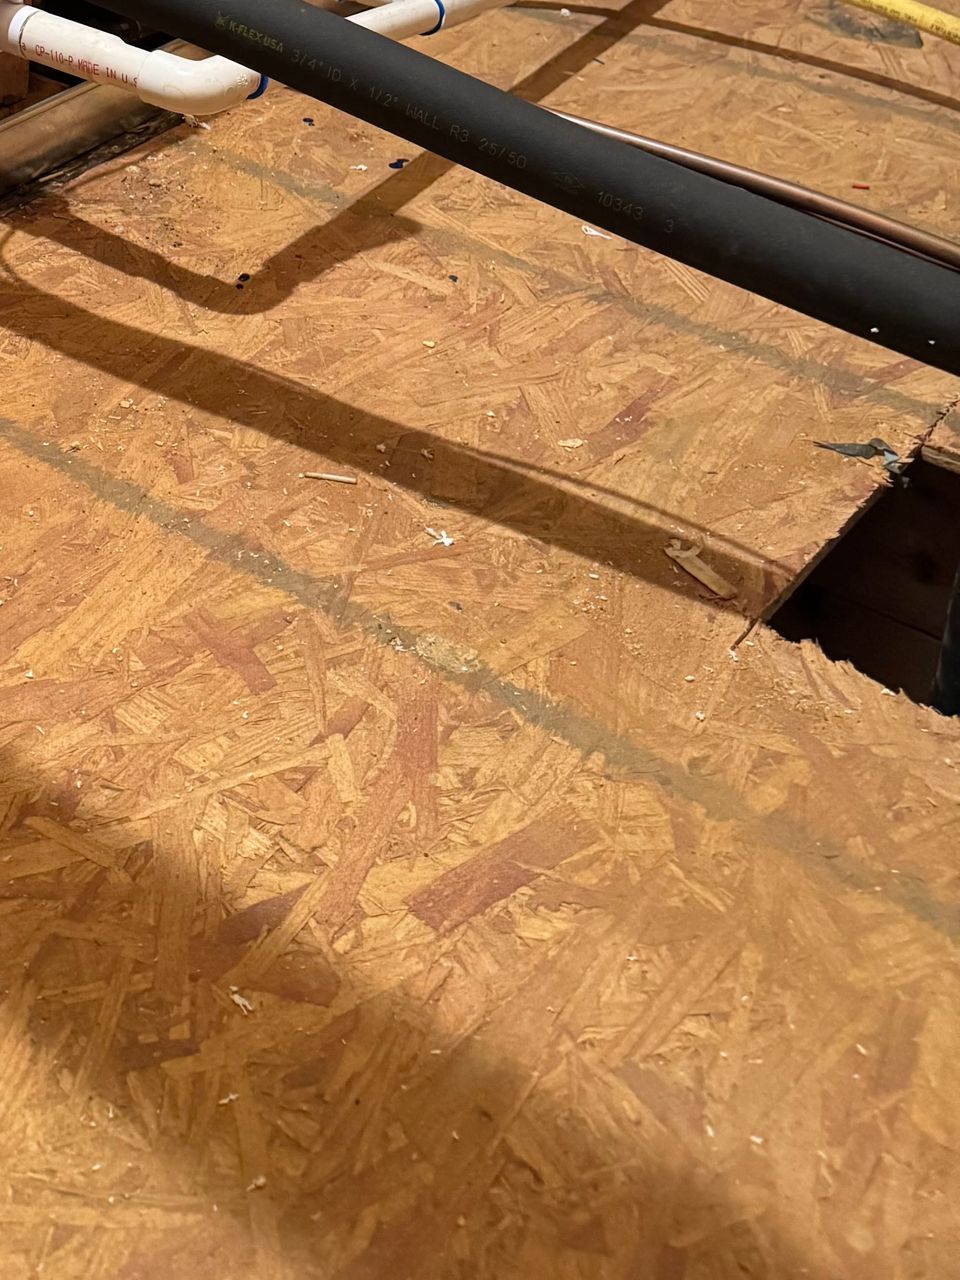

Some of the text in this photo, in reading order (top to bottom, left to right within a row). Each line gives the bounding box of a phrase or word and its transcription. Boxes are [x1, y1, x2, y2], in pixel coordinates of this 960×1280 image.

[78, 58, 100, 76] MADE
[106, 66, 117, 80] IN
[406, 105, 441, 131] WALL
[449, 124, 470, 144] R3
[478, 137, 528, 169] 25/50
